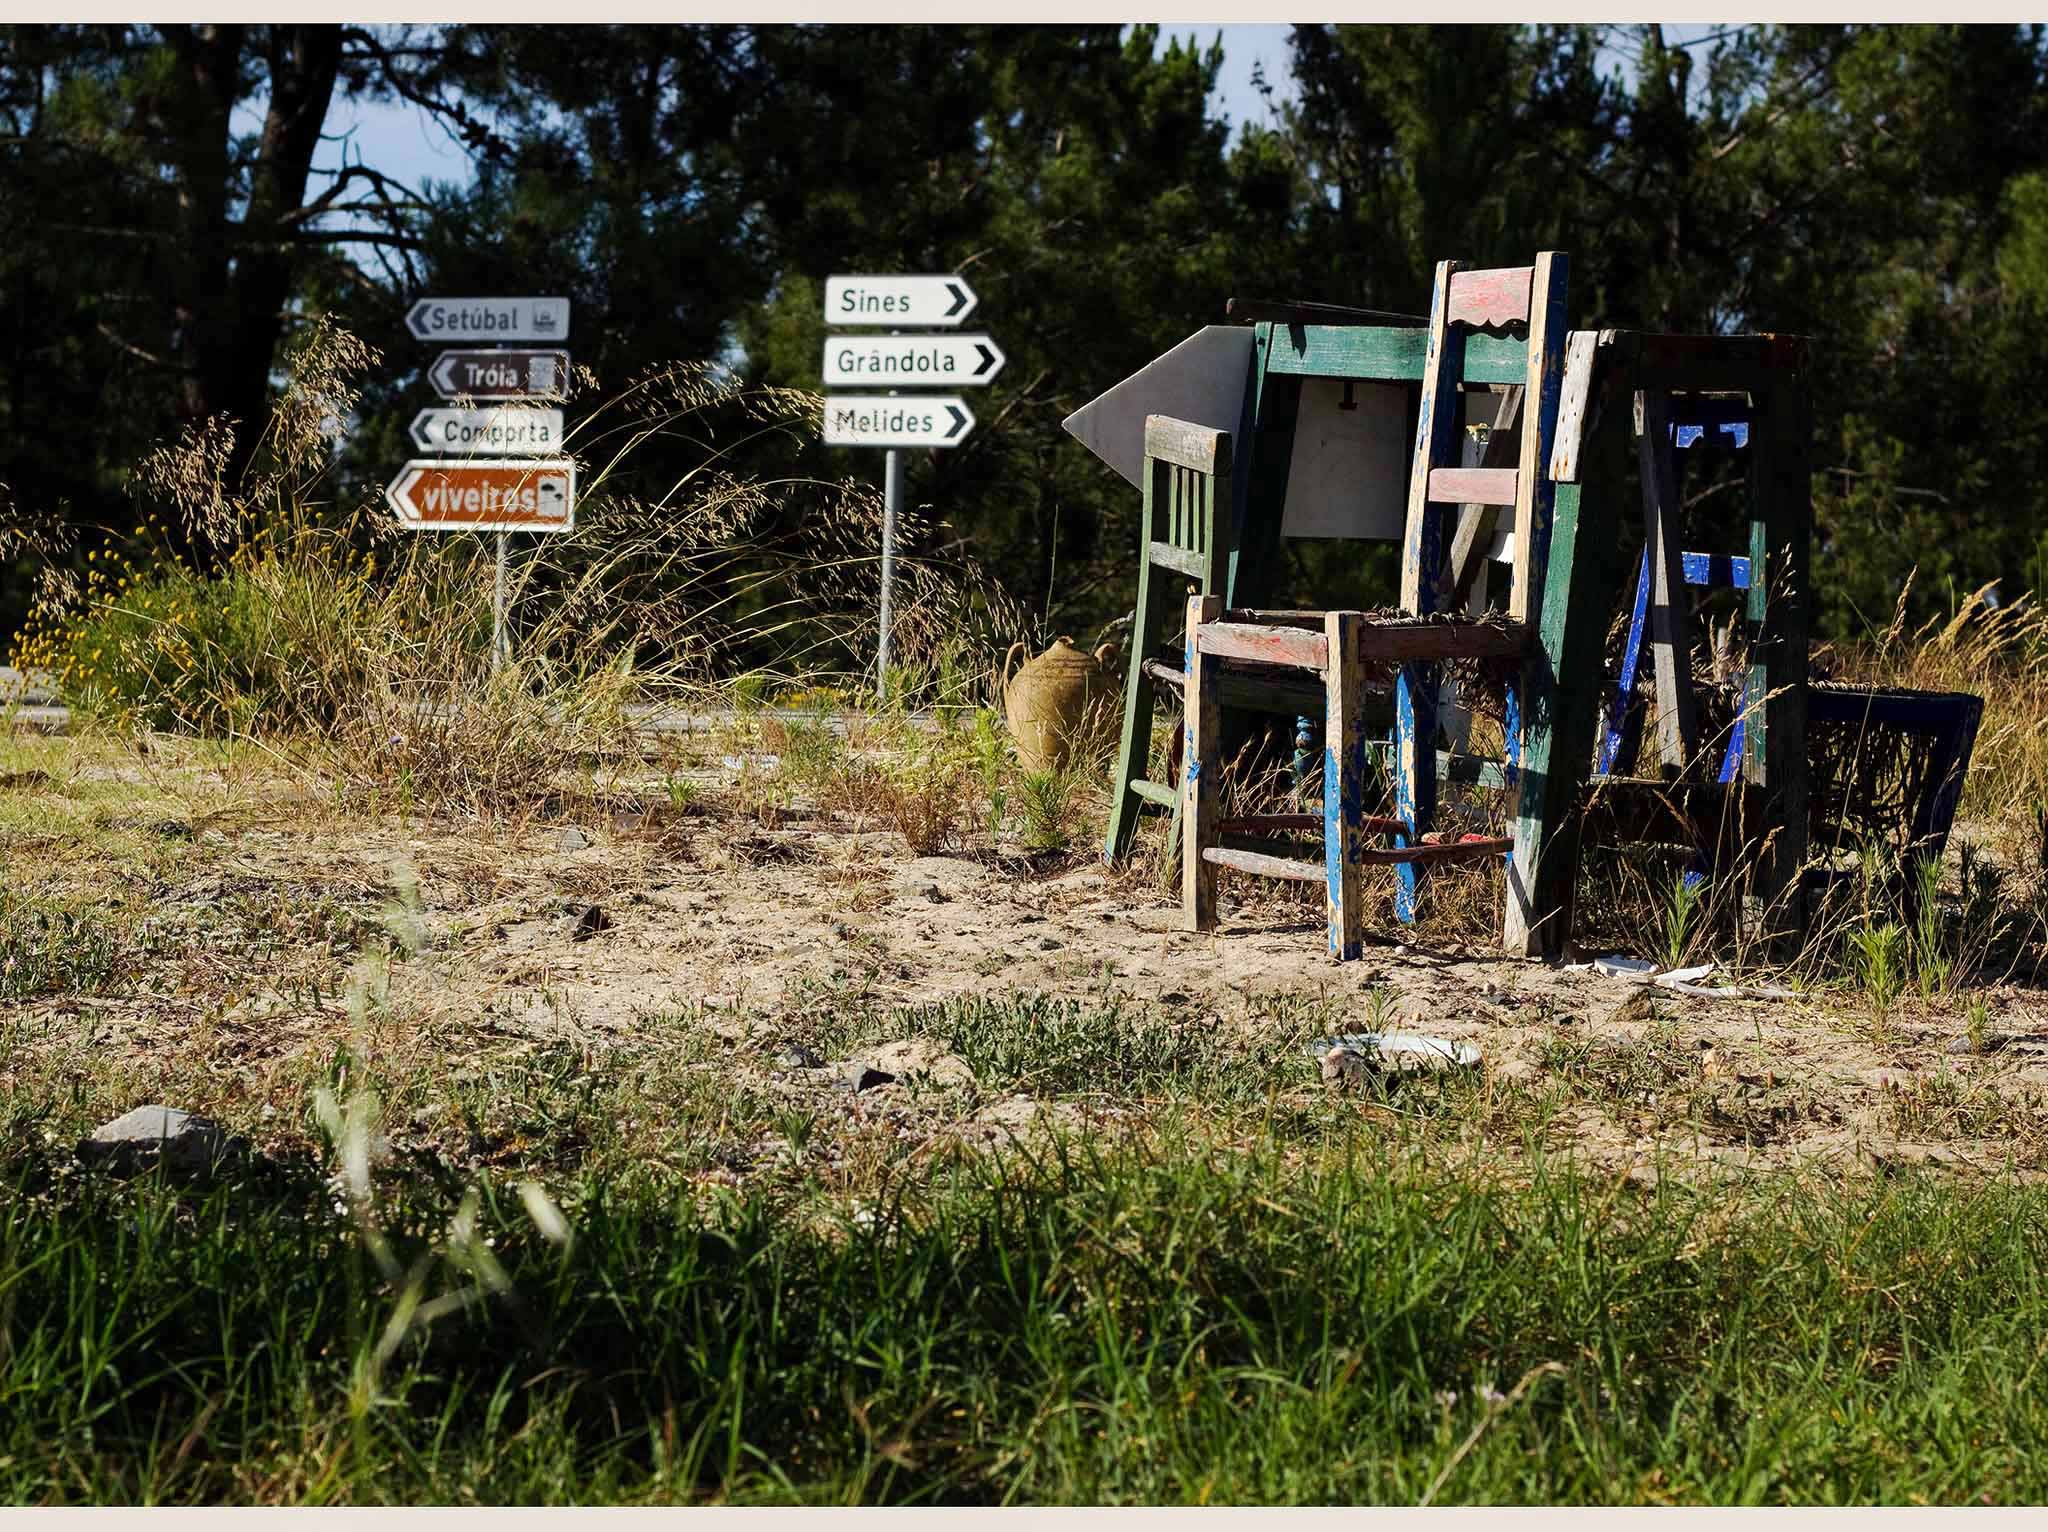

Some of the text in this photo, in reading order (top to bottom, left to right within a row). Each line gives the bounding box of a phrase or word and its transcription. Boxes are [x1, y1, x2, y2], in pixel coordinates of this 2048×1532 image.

[840, 289, 911, 312] Sines
[431, 306, 518, 331] Setúbal
[838, 349, 956, 373] Grândola
[836, 409, 933, 433] Melides
